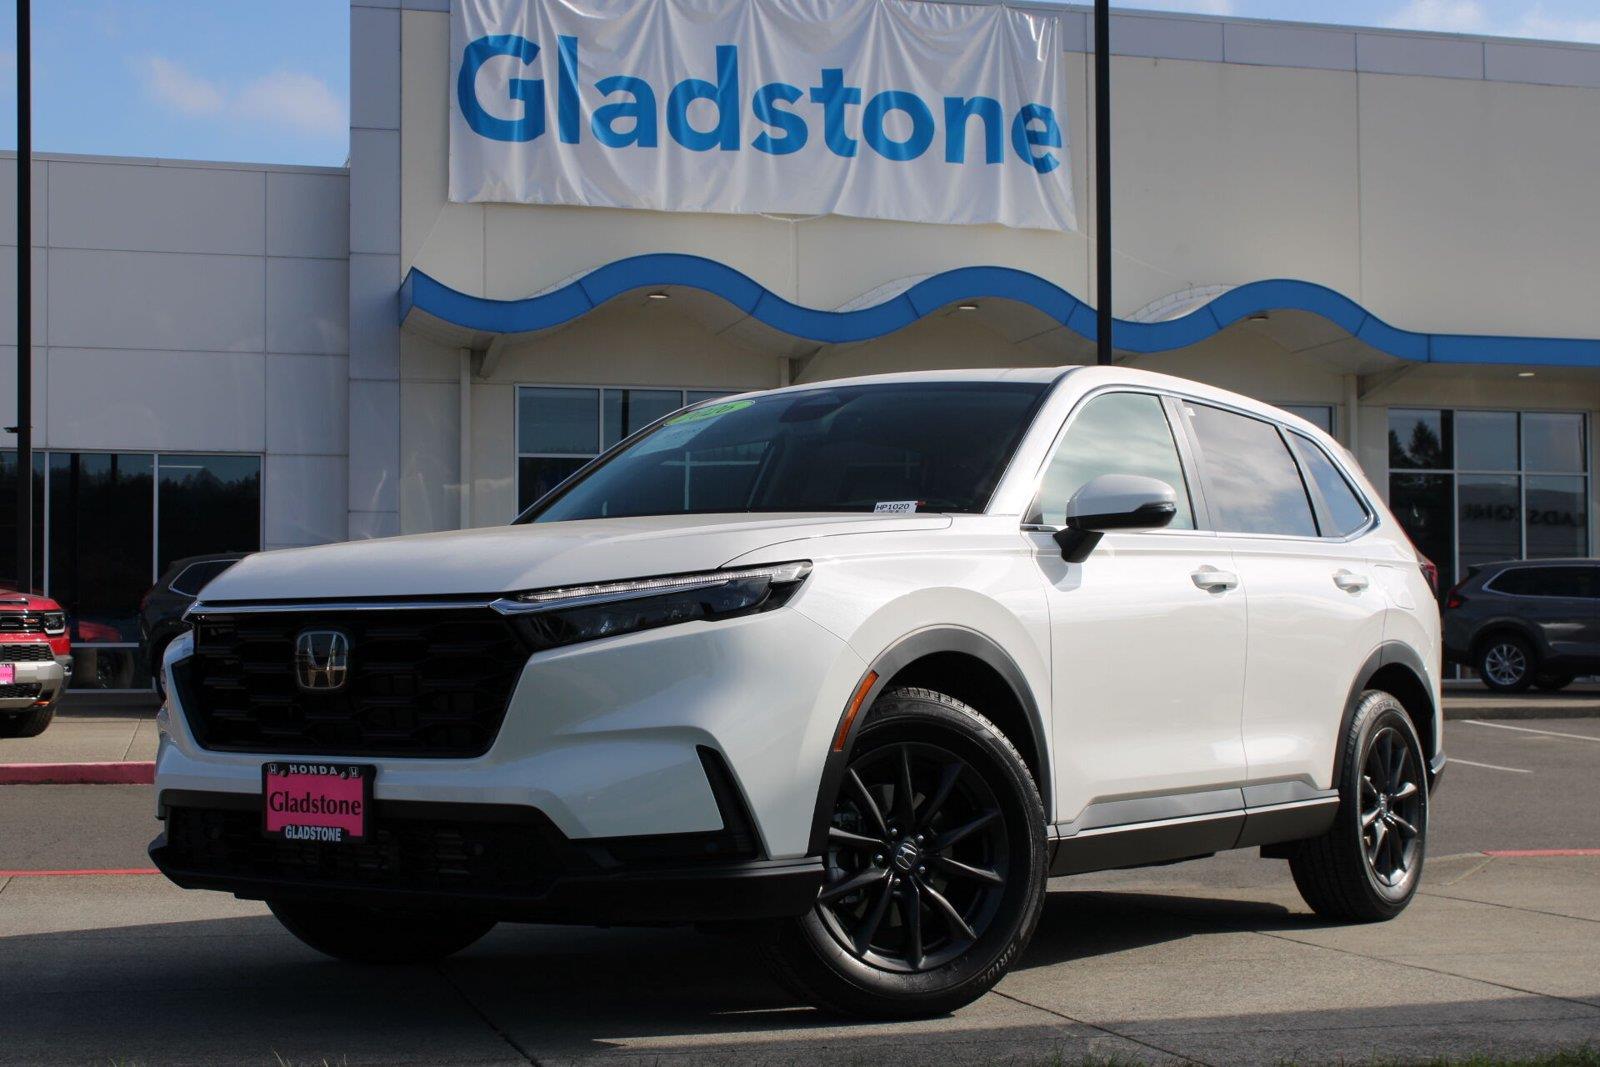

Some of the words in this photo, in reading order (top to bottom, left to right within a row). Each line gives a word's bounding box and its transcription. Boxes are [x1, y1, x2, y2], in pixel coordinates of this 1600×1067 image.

[457, 33, 1063, 174] Gladstone
[289, 764, 338, 775] HONDA
[269, 791, 362, 816] Gladstone
[285, 825, 342, 841] GLADSTONE
